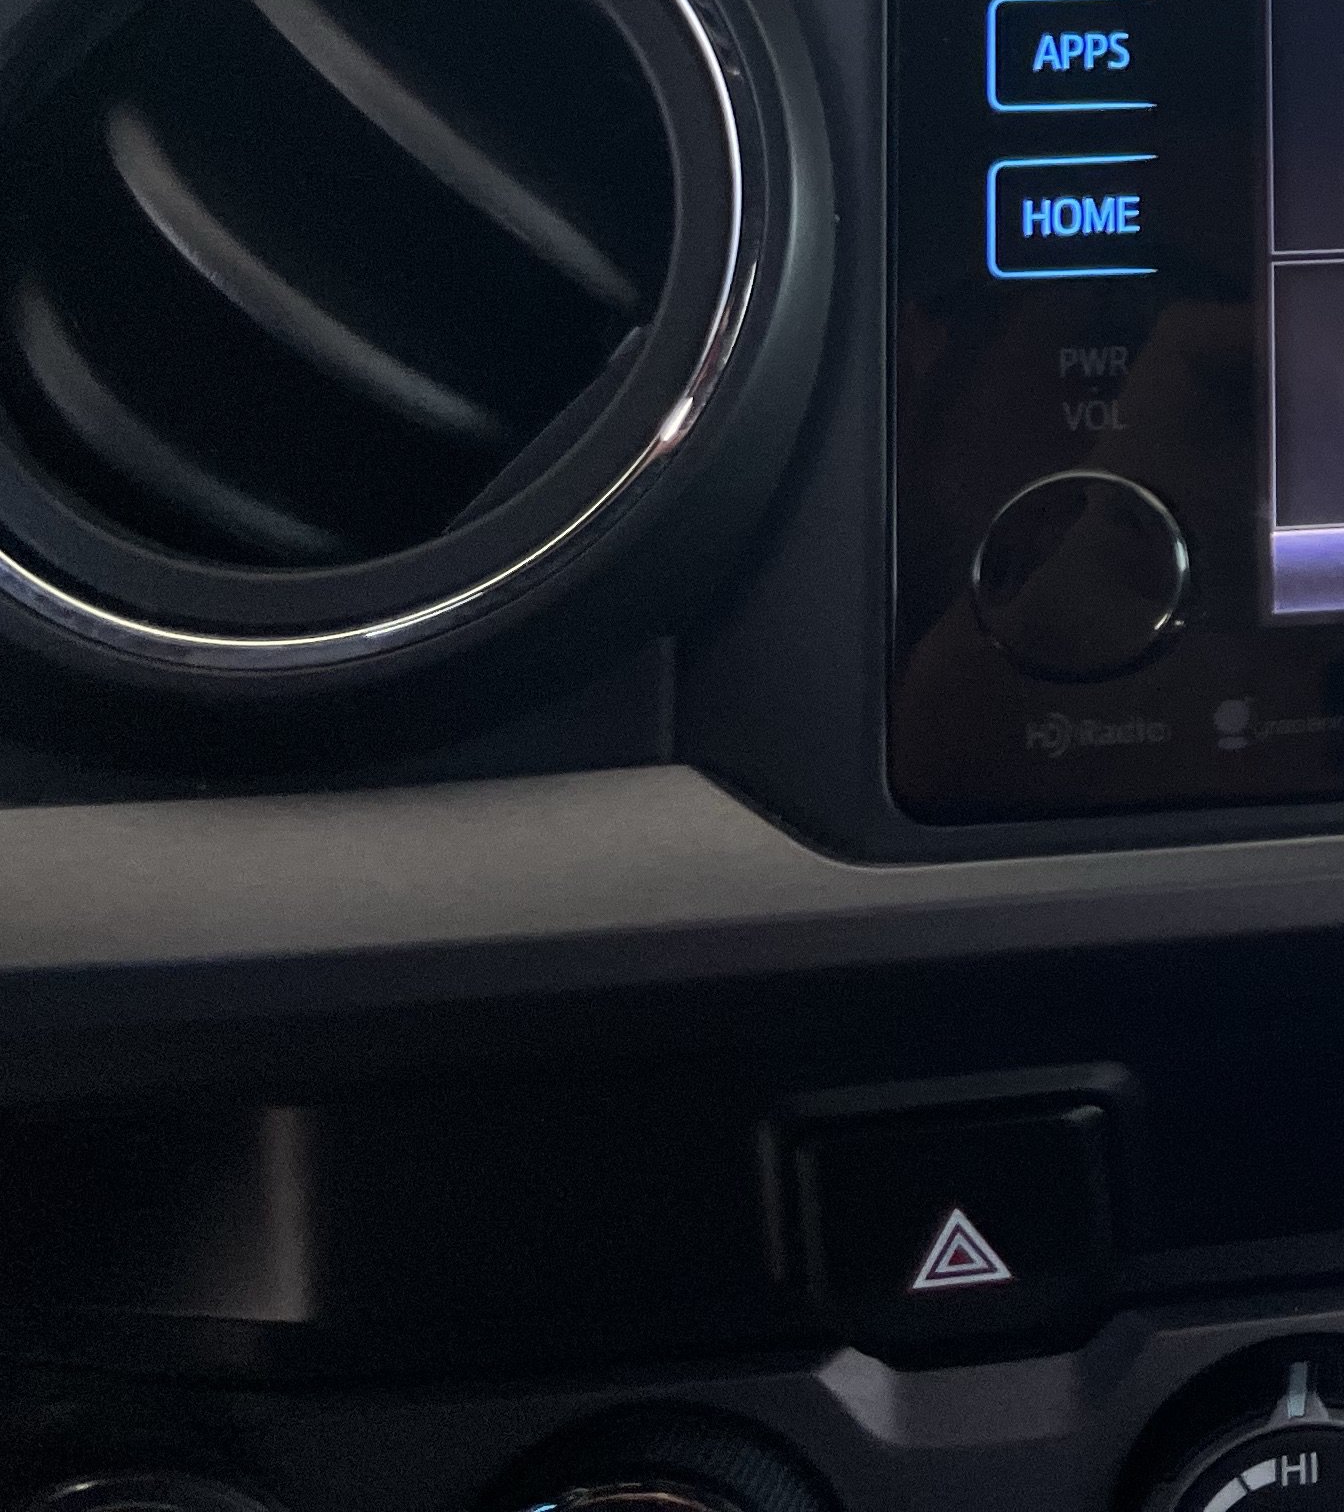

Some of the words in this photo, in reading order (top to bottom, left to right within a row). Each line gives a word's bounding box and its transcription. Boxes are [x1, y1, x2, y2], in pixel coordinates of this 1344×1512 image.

[1032, 30, 1131, 73] APPS
[1021, 194, 1141, 238] HOME
[1057, 344, 1131, 379] PWR
[1060, 398, 1130, 432] VOL
[1279, 1451, 1319, 1487] HI
